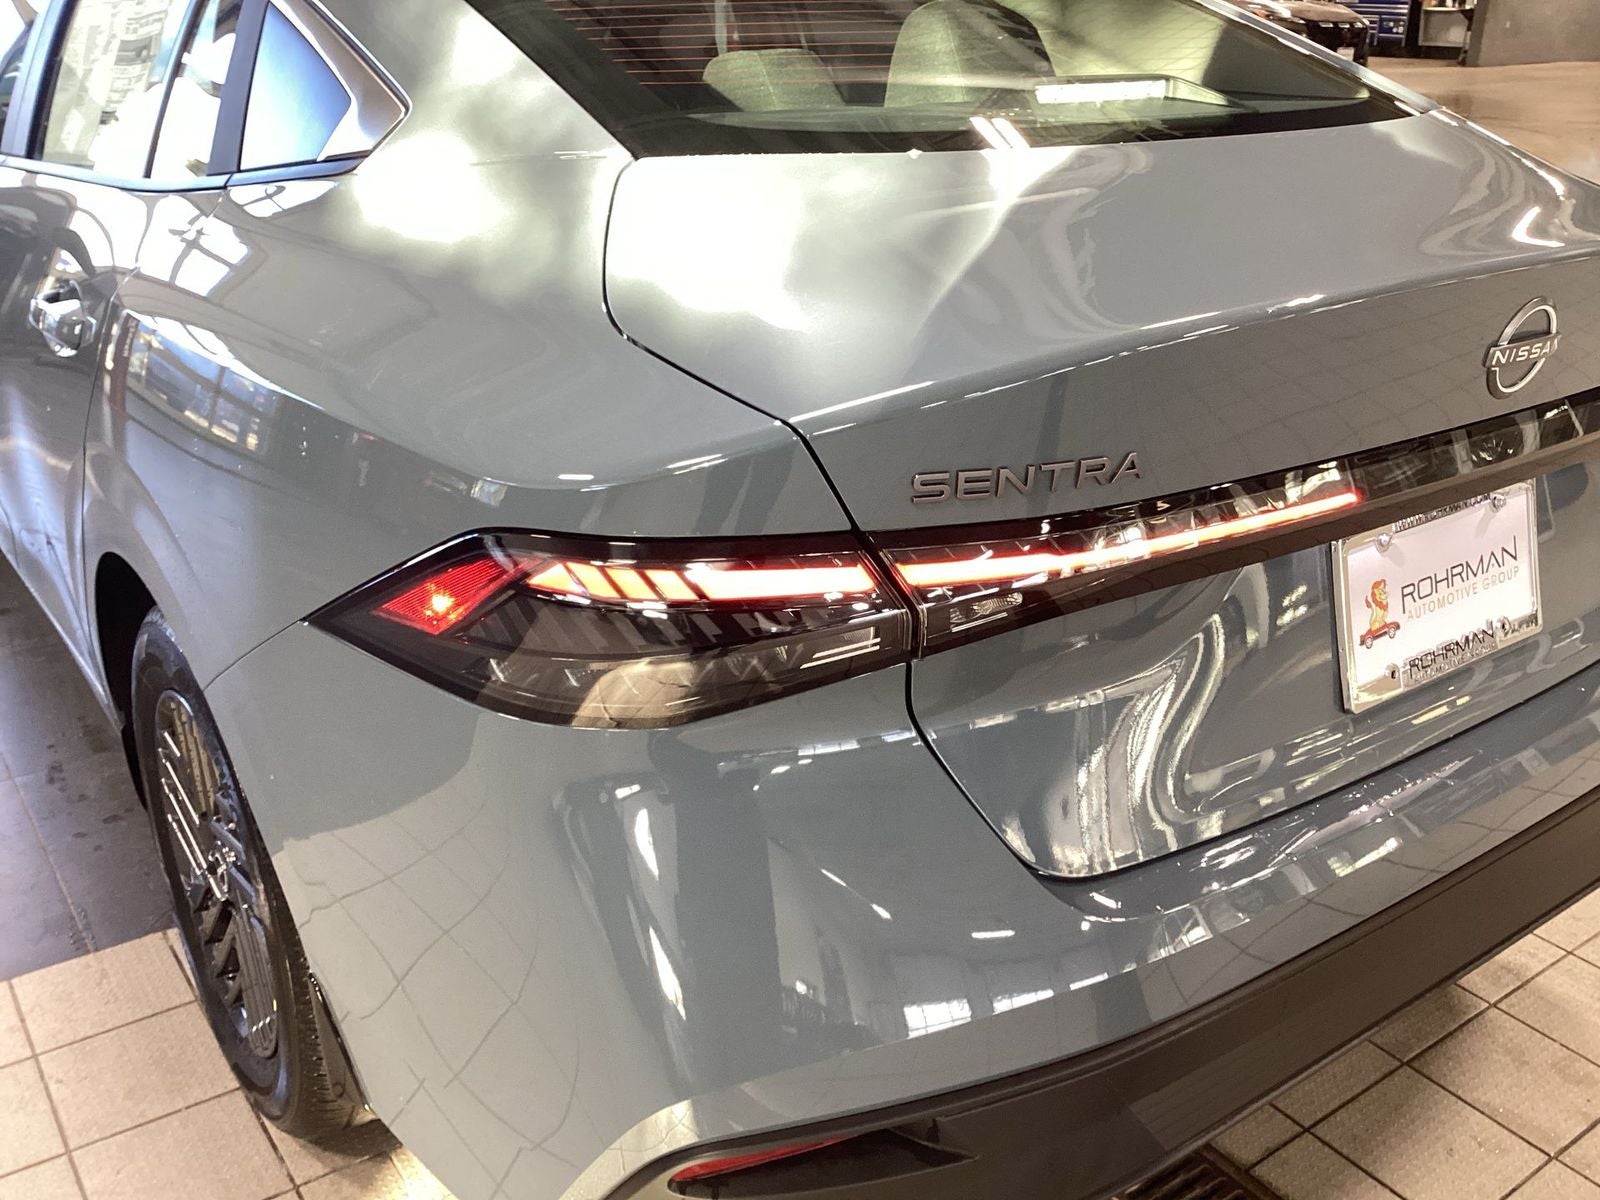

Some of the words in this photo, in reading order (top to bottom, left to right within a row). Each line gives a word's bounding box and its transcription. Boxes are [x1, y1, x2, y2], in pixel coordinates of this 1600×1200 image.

[911, 452, 1142, 503] SENTRA
[1401, 536, 1518, 615] ROHRMAN
[1407, 582, 1478, 622] AUTOMOTIVE
[1482, 565, 1520, 590] GROUP
[1407, 619, 1494, 679] ROHRMAN
